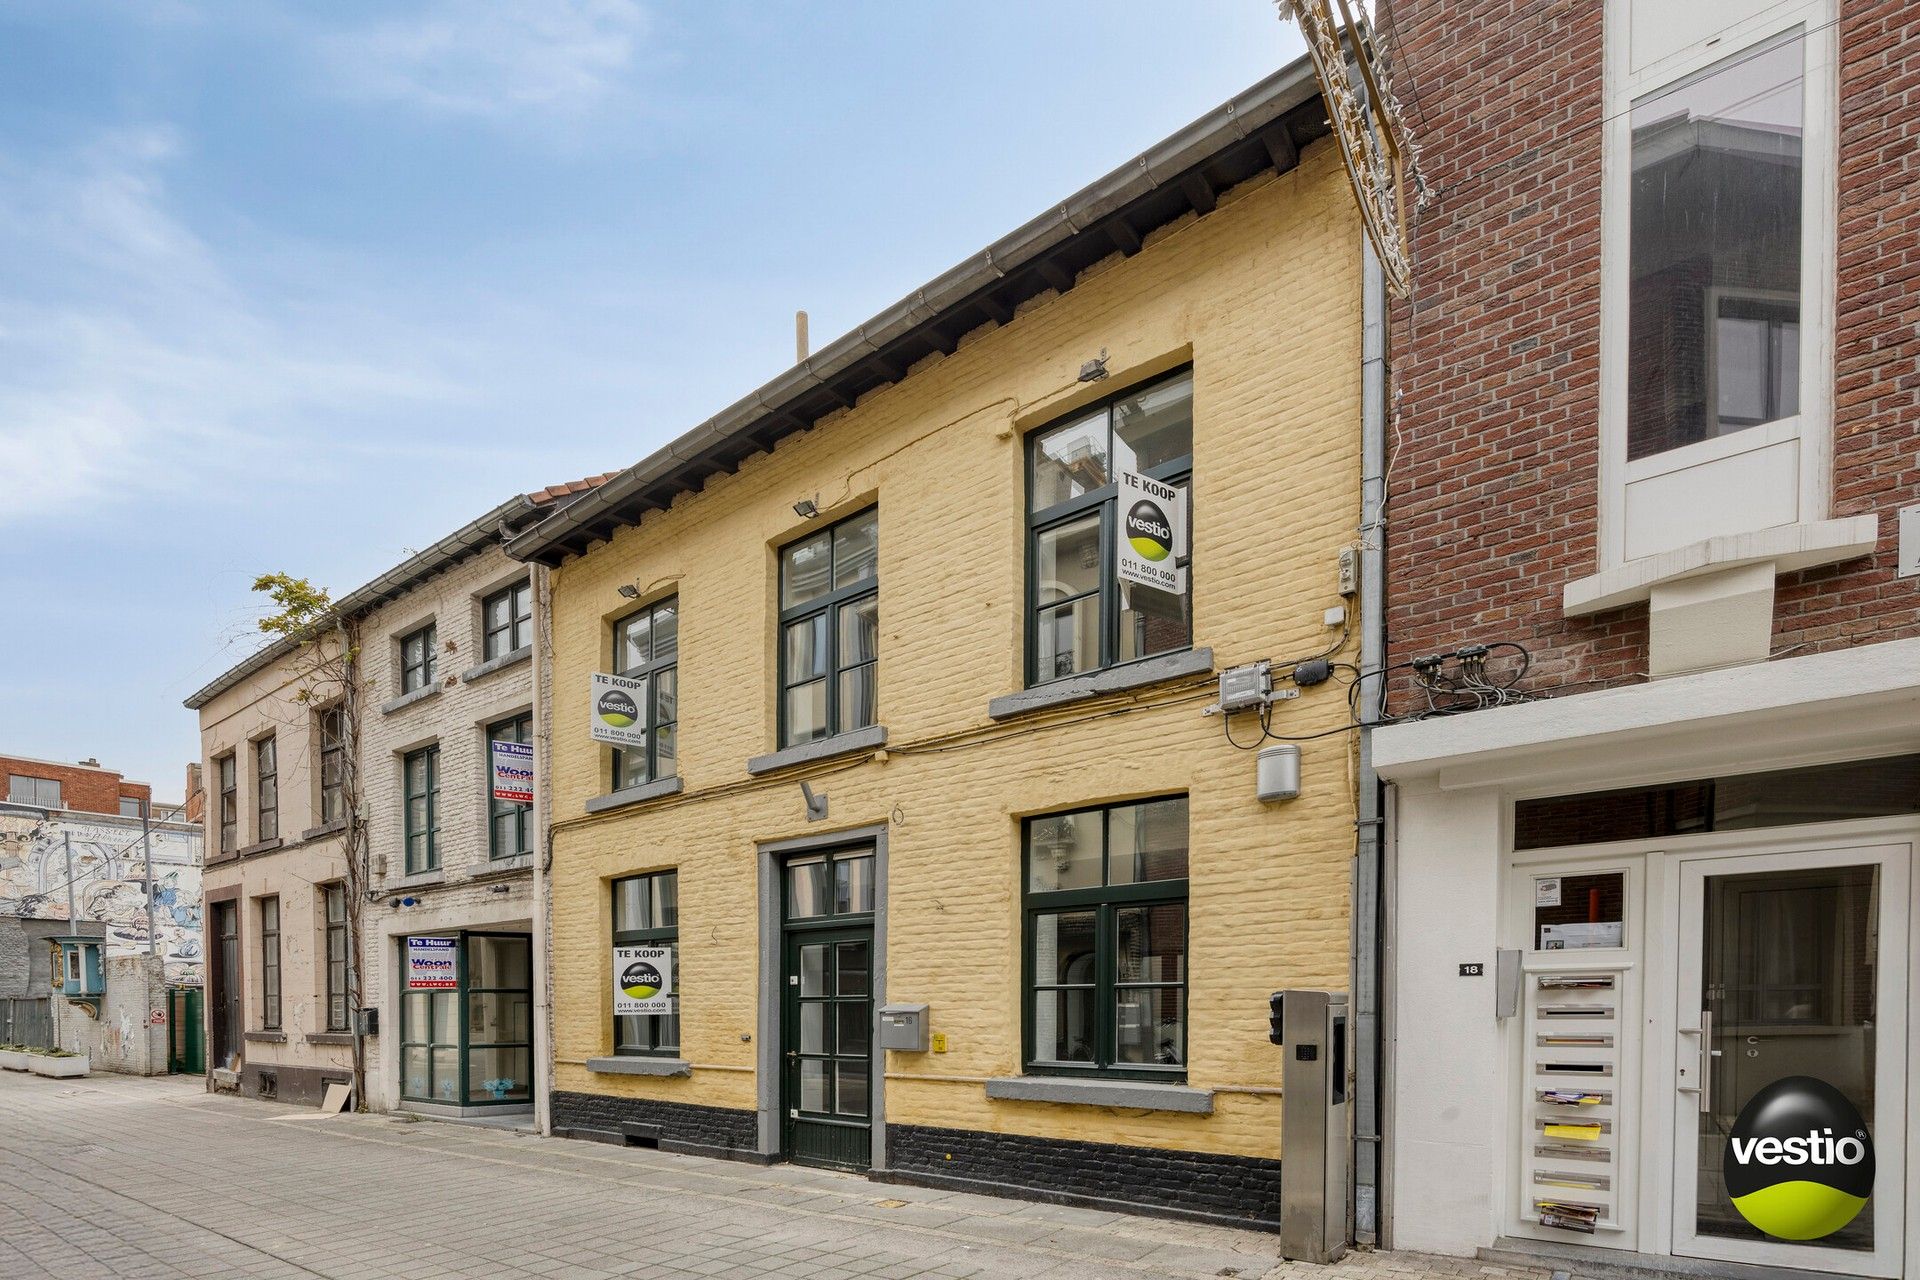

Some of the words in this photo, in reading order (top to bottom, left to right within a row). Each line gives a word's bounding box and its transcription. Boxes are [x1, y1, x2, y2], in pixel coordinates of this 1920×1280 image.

[1123, 472, 1139, 489] TE
[1143, 479, 1176, 502] KOOP
[1121, 558, 1137, 570] 011
[1141, 565, 1157, 577] 800
[1160, 570, 1176, 583] 000
[1121, 568, 1176, 590] www.vestio.com
[595, 674, 609, 685] TE
[612, 678, 641, 689] KOOP
[594, 734, 641, 744] www.vestio.com
[610, 729, 625, 737] 800
[627, 732, 641, 740] 000
[494, 743, 508, 751] Te
[510, 745, 533, 754] Huu
[496, 766, 533, 777] Woo
[617, 950, 631, 958] TE
[635, 950, 665, 958] KOOP
[1464, 966, 1479, 974] 18
[622, 973, 660, 983] vestio
